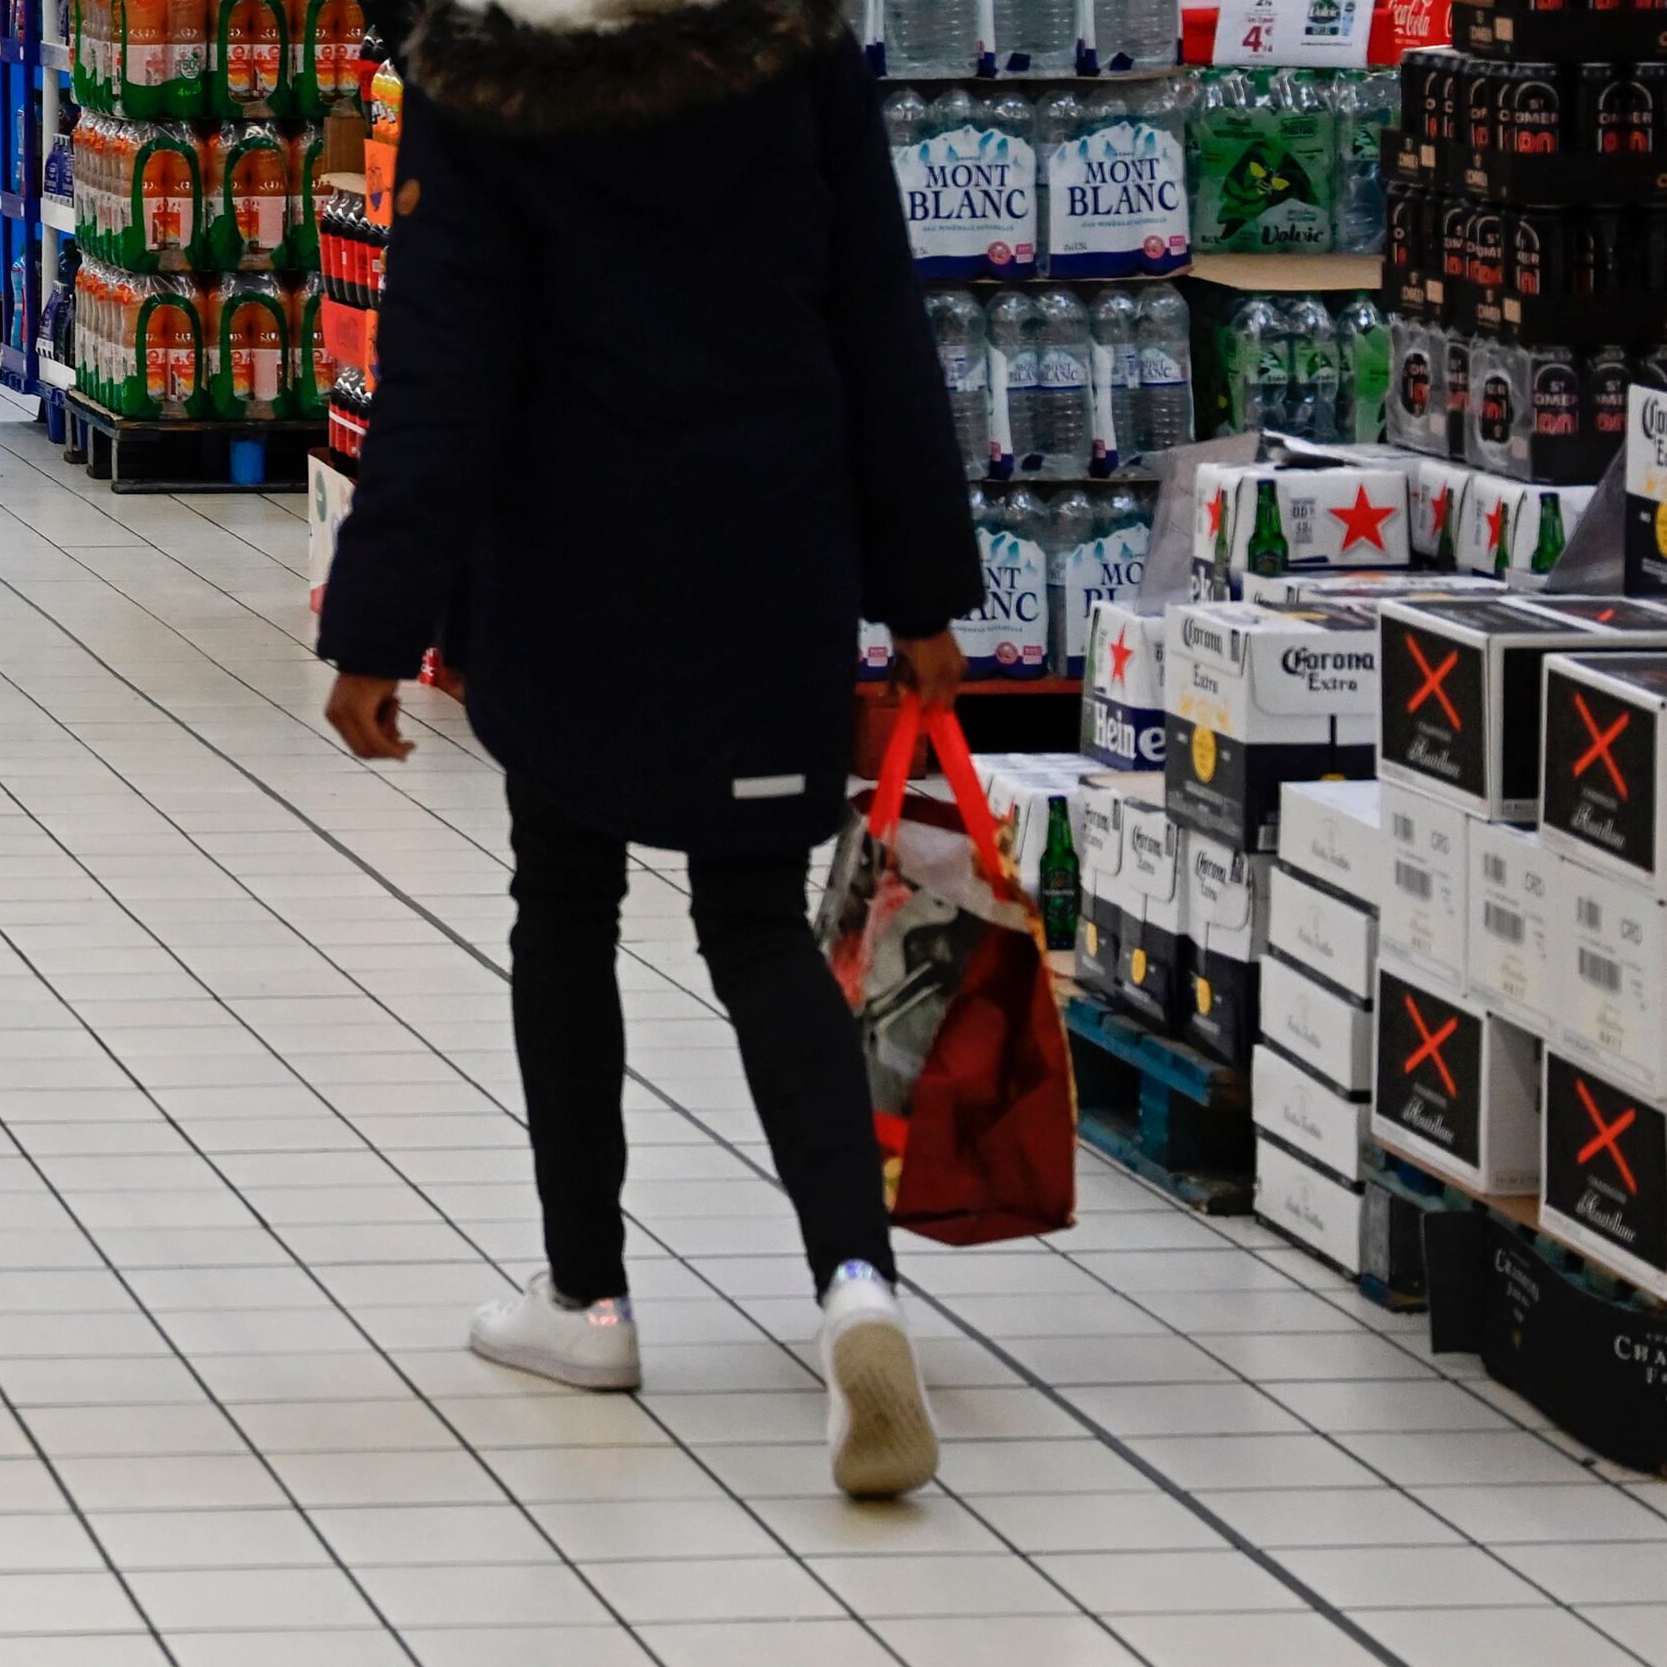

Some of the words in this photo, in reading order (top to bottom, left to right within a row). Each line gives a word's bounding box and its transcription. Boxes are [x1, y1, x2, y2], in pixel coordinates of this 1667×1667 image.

[925, 164, 1010, 189] MONT
[1085, 157, 1161, 183] MONT
[908, 189, 1030, 222] BLANC
[1068, 180, 1180, 217] BLANC
[1261, 223, 1325, 246] Volvic
[1182, 618, 1223, 656] Corona
[1282, 646, 1375, 678] Corona
[1307, 673, 1358, 692] Extra
